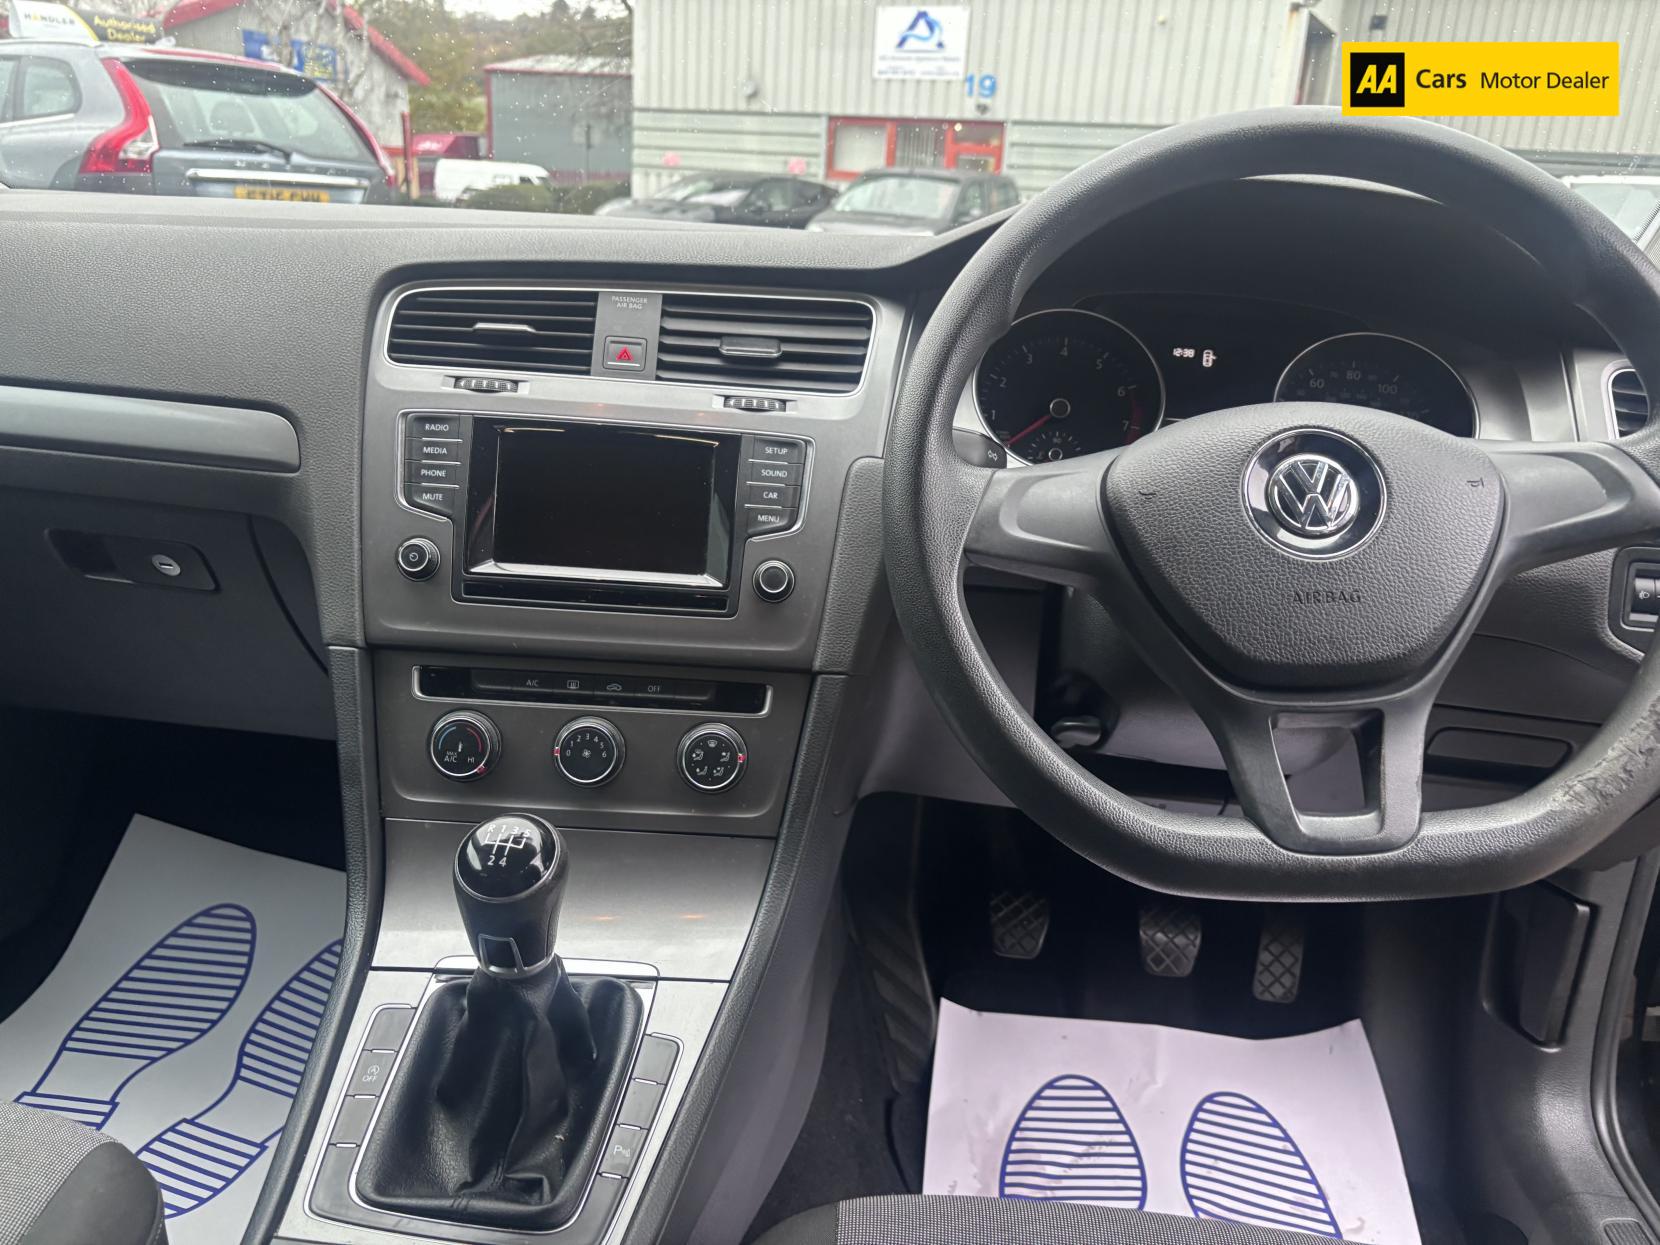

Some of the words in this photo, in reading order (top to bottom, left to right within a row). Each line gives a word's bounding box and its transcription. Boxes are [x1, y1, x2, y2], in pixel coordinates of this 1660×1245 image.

[966, 73, 997, 98] 19
[611, 295, 648, 304] PASSENGER
[1060, 346, 1068, 356] 4
[1026, 353, 1033, 364] 3
[1096, 359, 1103, 370] 5
[1346, 370, 1361, 380] 80
[999, 377, 1007, 387] 2
[1309, 377, 1325, 389] 60
[1117, 386, 1125, 396] 6
[1378, 383, 1398, 394] 100
[991, 410, 996, 420] 1
[425, 423, 449, 432] RADIO
[1122, 420, 1129, 431] 7
[423, 446, 447, 455] MEDIA
[765, 446, 788, 455] SETUP
[421, 469, 446, 477] PHONE
[761, 469, 787, 478] SOUND
[422, 492, 443, 501] MUTE
[763, 491, 778, 499] CAR
[757, 514, 780, 523] MENU
[1293, 590, 1361, 605] AIRBAG
[526, 679, 539, 687] A/C
[648, 685, 660, 693] OFF
[566, 749, 571, 757] 0
[444, 755, 457, 763] A/C
[488, 824, 496, 832] R
[501, 824, 507, 833] 1
[512, 826, 519, 835] 3
[523, 829, 531, 837] 5
[487, 855, 495, 866] 2
[499, 856, 507, 867] 4
